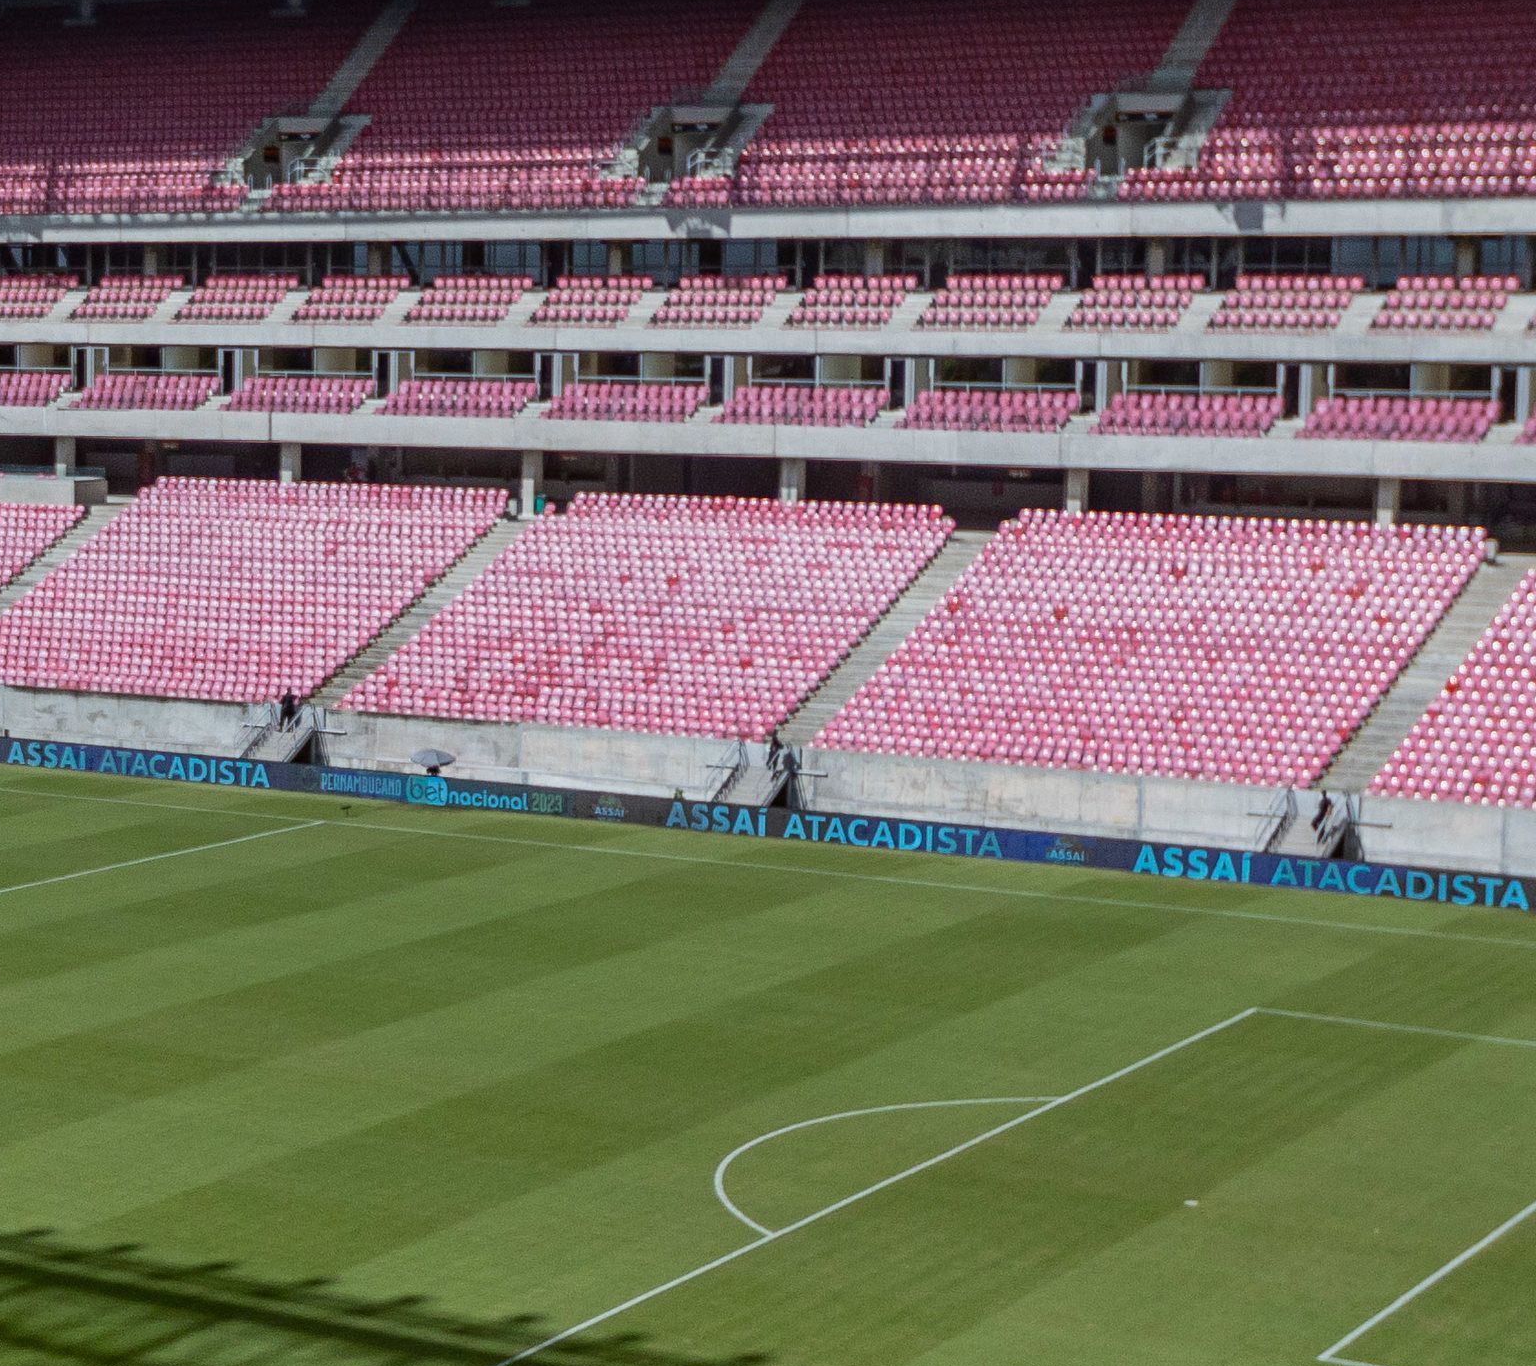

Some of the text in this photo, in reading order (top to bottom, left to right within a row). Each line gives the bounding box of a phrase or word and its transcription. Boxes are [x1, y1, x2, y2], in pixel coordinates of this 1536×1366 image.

[99, 748, 271, 788] ATACADISTA
[321, 772, 401, 796] PERNAMBUCANO
[532, 792, 563, 813] 2023
[783, 813, 1002, 858] ATACADISTA
[1270, 858, 1529, 910] ATACADISTA
